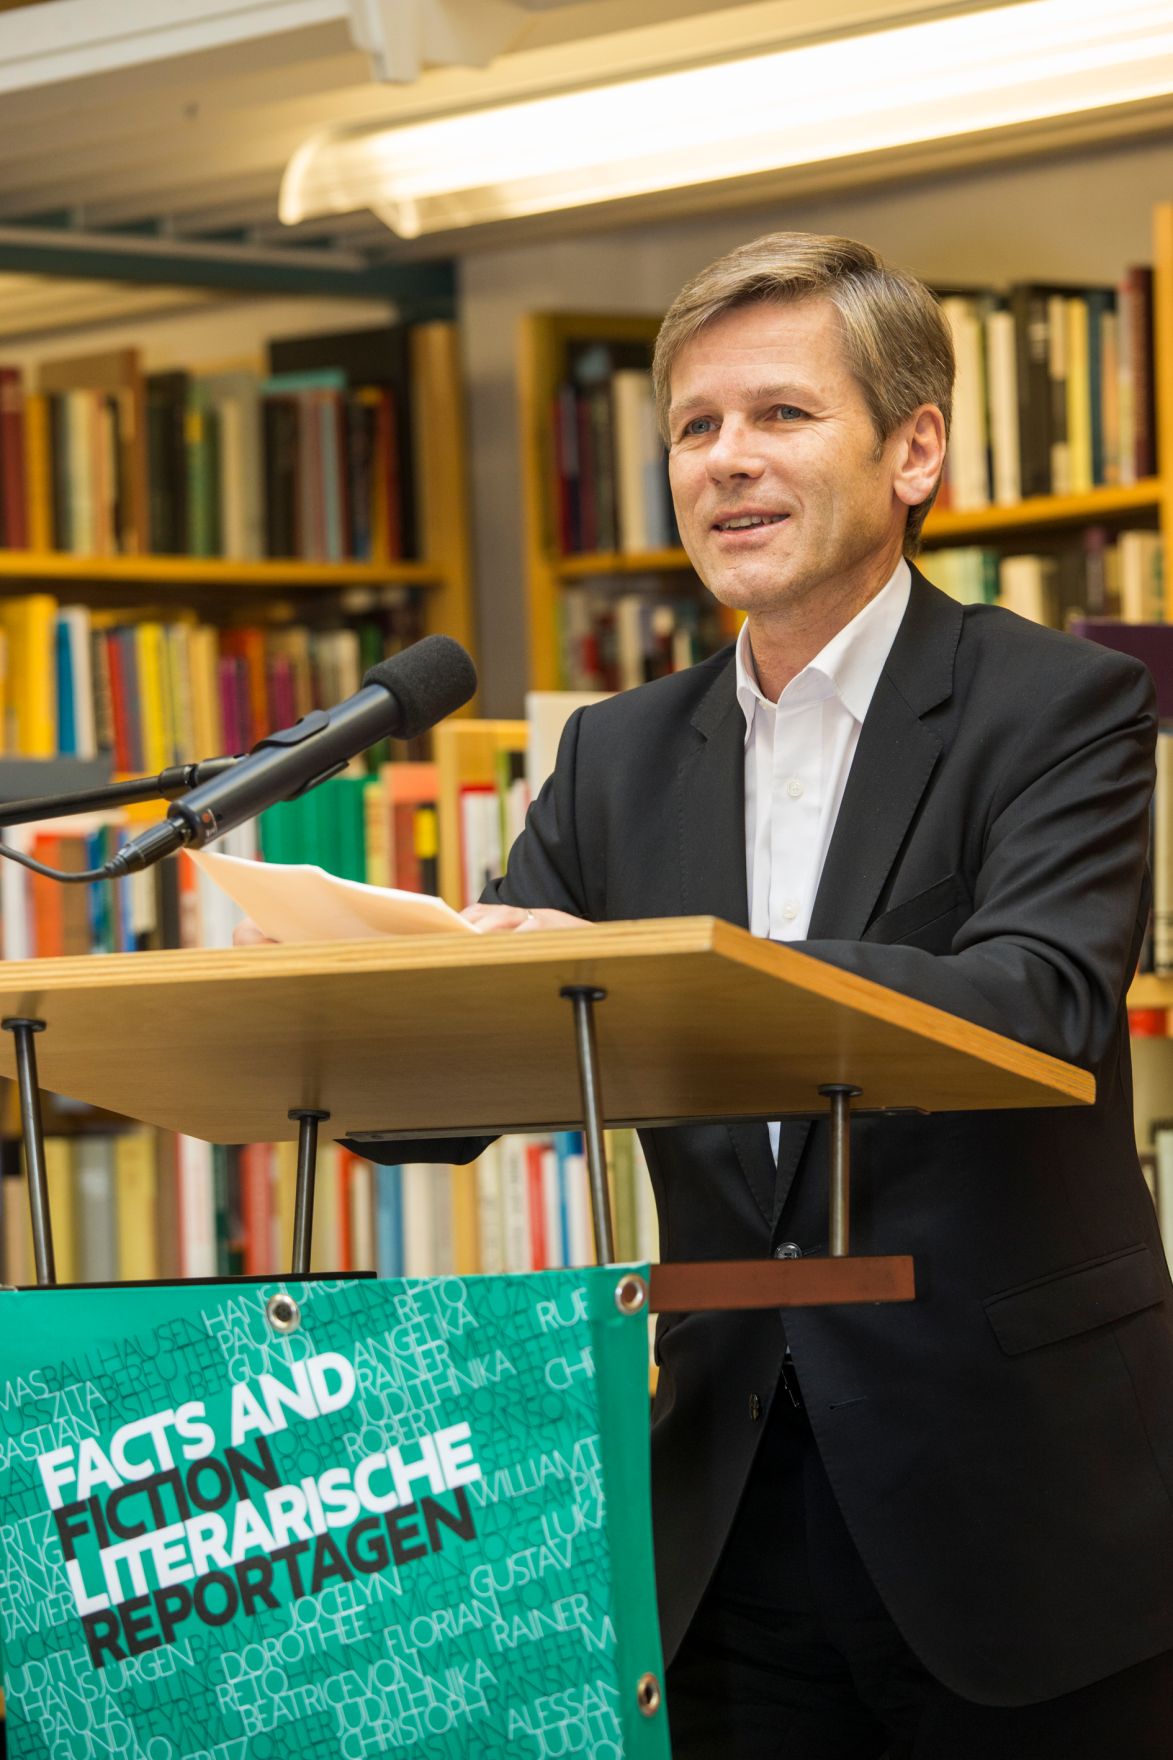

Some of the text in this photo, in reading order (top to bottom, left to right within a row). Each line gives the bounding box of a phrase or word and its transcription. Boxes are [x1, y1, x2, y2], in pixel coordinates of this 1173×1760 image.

[227, 1332, 317, 1384] GUNDI
[393, 1277, 466, 1323] RETO
[356, 1303, 479, 1370] ANGELIKA
[356, 1339, 454, 1398] RAINER
[37, 1381, 107, 1423] ZITA
[98, 1336, 225, 1403] BEREUTER
[37, 1352, 356, 1510] FACTS AND
[343, 1402, 440, 1462] ROBERT
[53, 1436, 281, 1561] FICTION
[65, 1421, 482, 1616] LITERARISCHE
[81, 1486, 477, 1669] REPORTAGEN
[289, 1566, 403, 1633] JOCELYN
[39, 1695, 125, 1745] PAULA
[220, 1605, 372, 1684] DOROTHEE
[471, 1537, 571, 1596] GUSTAV
[215, 1668, 287, 1714] RETO
[384, 1592, 502, 1657] FLORIAN
[491, 1593, 593, 1651] RAINER
[6, 1644, 93, 1700] JUDITH
[341, 1687, 490, 1760] CHRISTOPH
